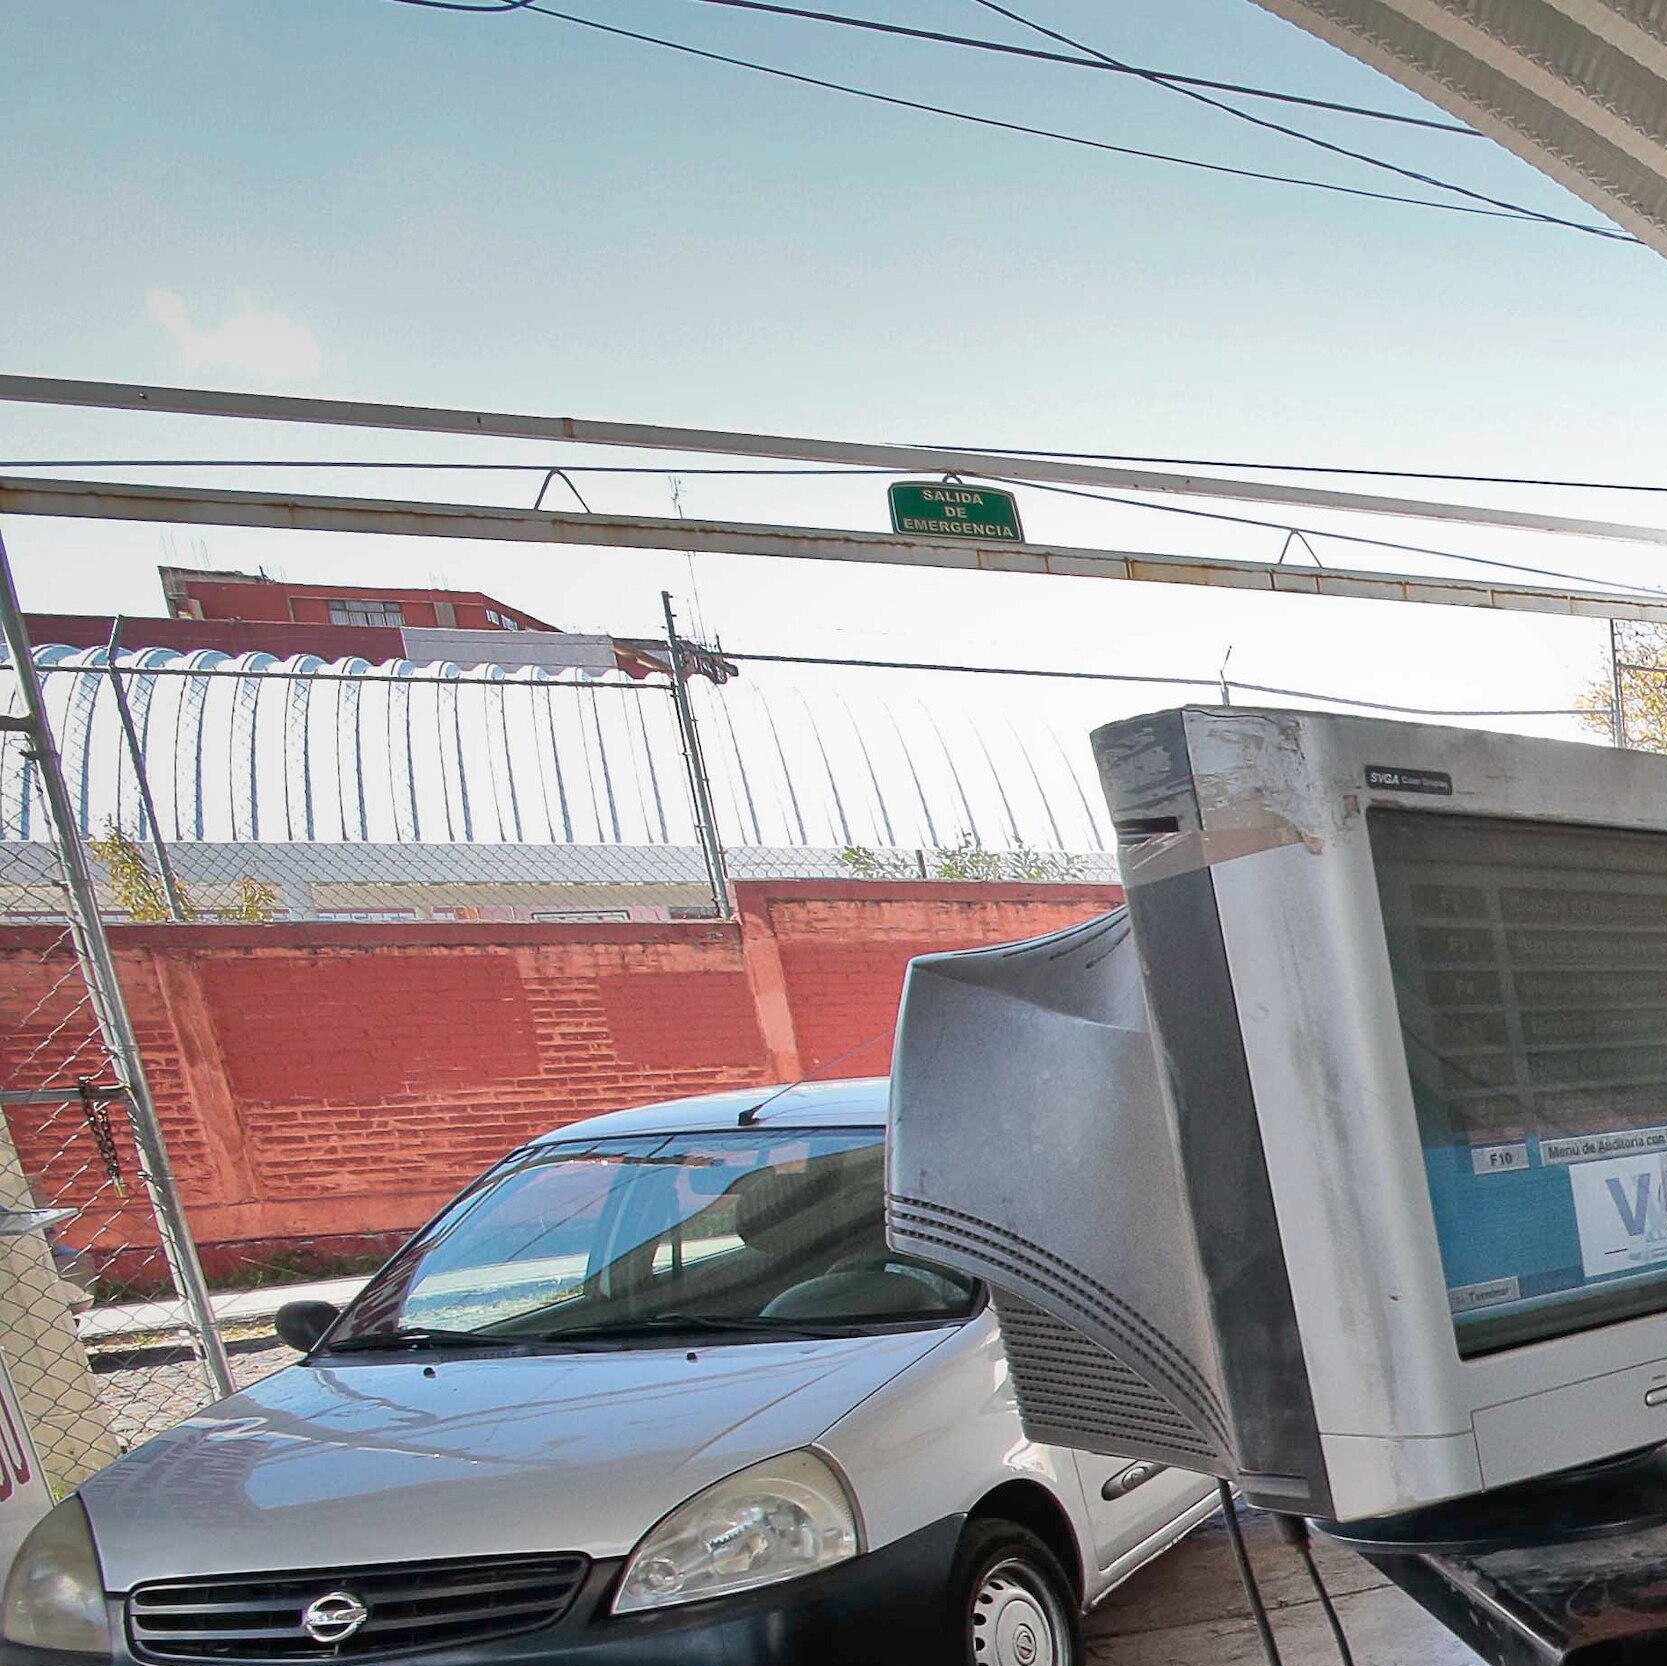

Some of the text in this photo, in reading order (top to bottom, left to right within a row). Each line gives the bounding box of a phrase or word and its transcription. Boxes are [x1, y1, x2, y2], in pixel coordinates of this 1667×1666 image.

[923, 489, 983, 505] SALIDA
[944, 506, 967, 518] DE
[903, 518, 1013, 537] EMERGENCIA
[1370, 772, 1399, 784] SVGA
[1490, 1152, 1512, 1166] F10
[1583, 1142, 1596, 1155] de
[1647, 1135, 1665, 1146] con
